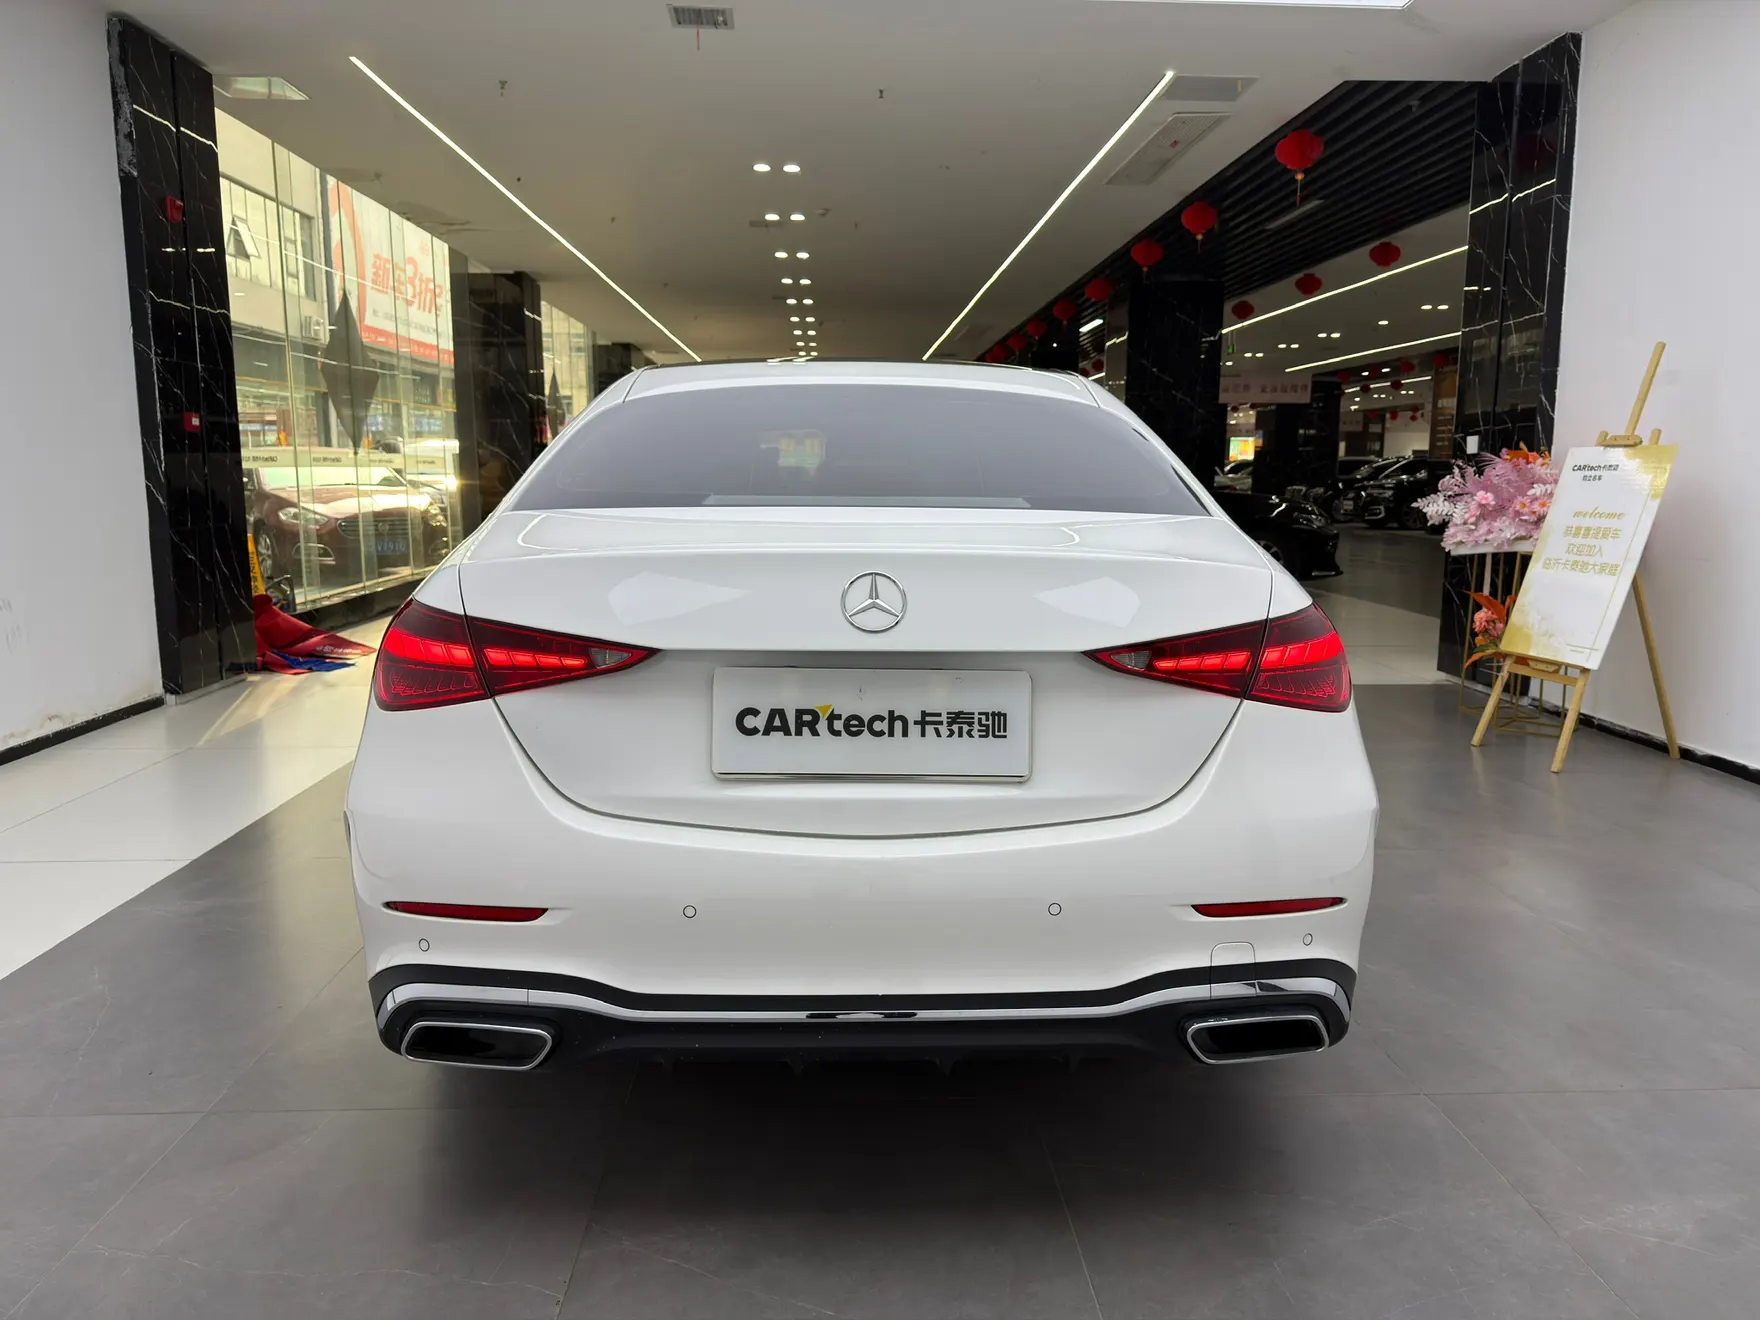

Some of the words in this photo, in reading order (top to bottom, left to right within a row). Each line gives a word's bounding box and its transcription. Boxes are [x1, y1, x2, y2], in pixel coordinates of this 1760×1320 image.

[1573, 506, 1626, 520] welcome
[1565, 543, 1603, 557] 欢迎加入
